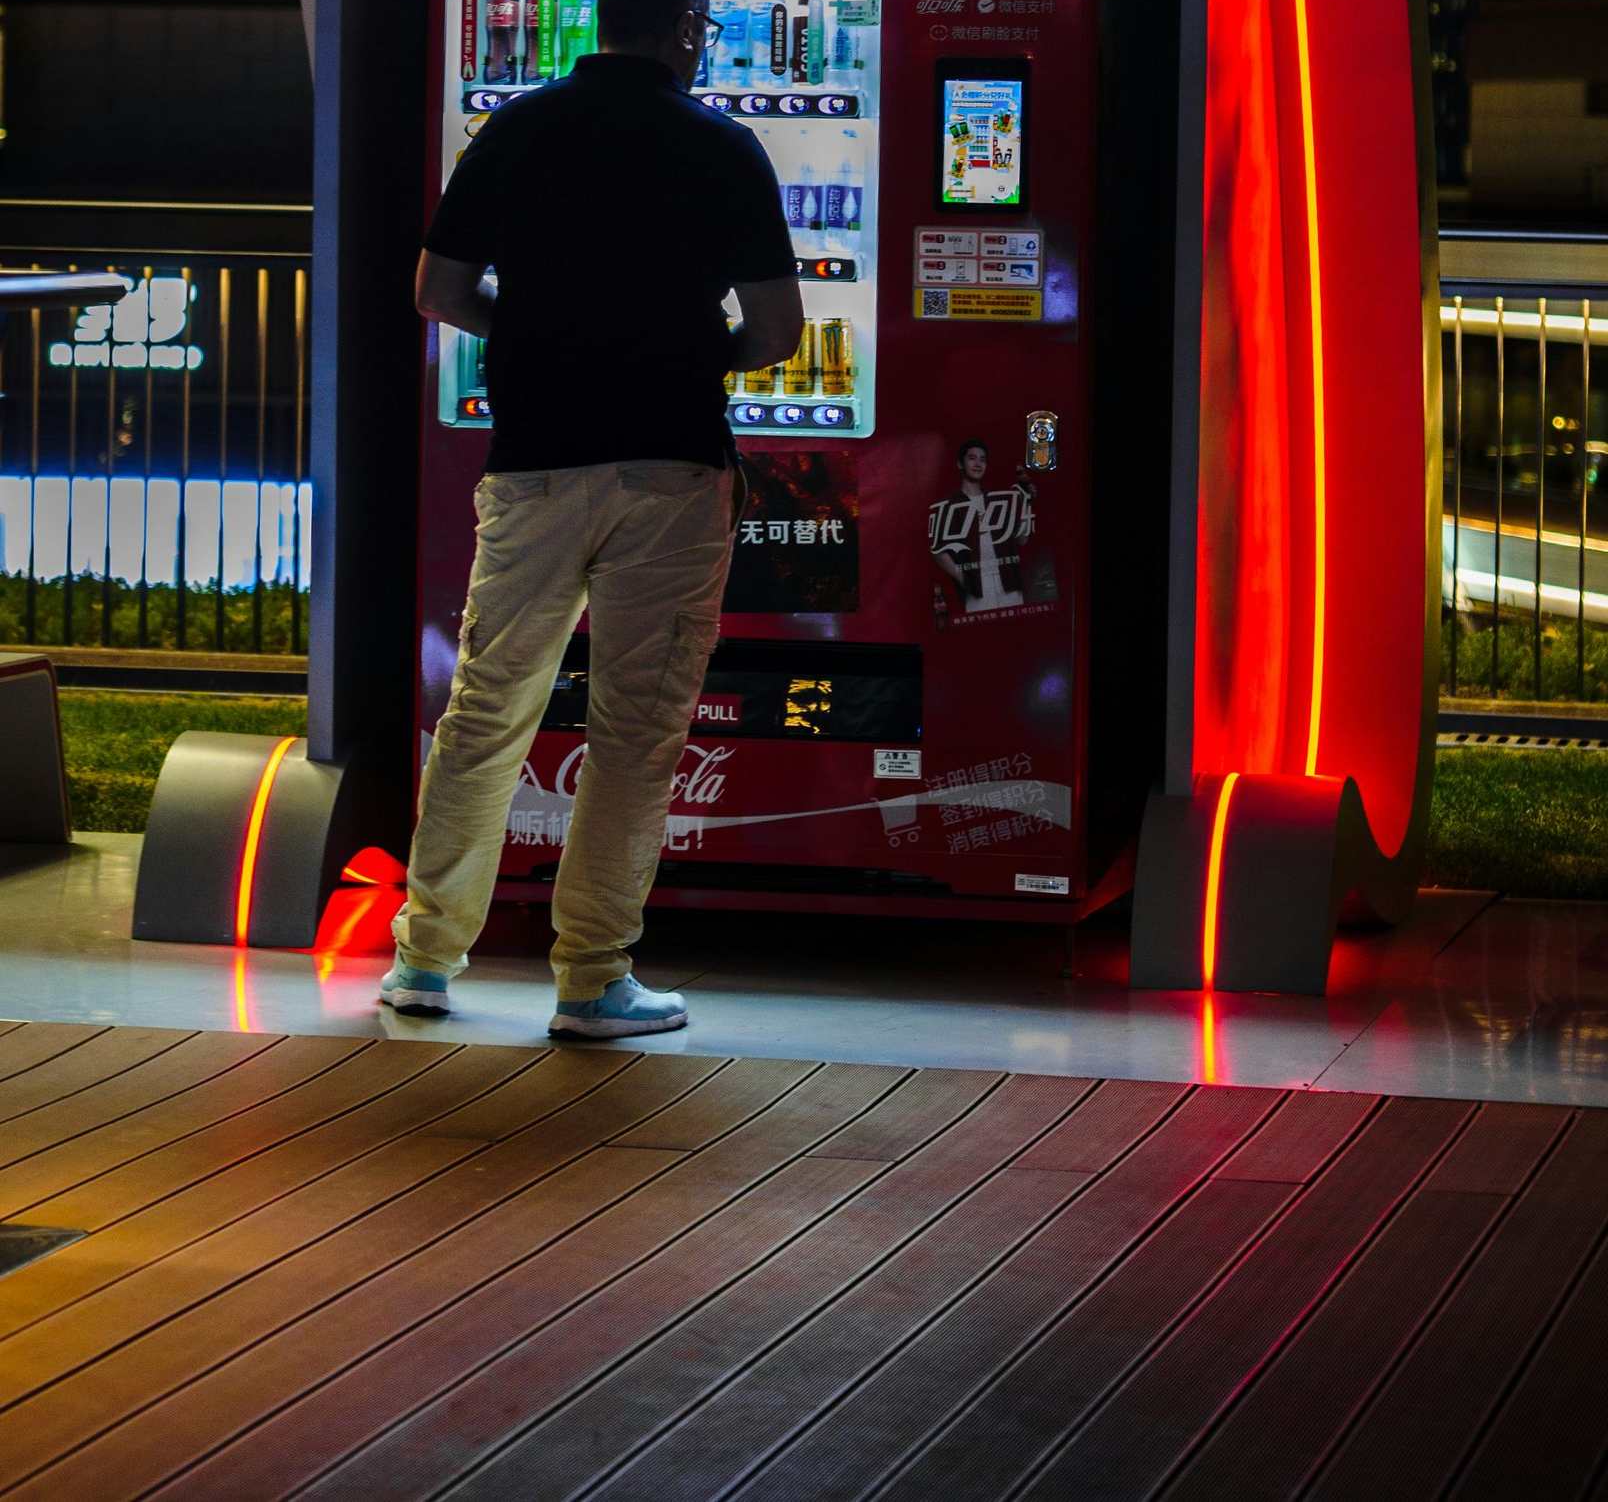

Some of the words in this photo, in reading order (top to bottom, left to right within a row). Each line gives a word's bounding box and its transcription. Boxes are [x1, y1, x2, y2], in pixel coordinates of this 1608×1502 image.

[998, 0, 1054, 14] 微信支付
[952, 26, 1040, 41] 微信刷脸支付
[740, 520, 845, 545] 无可替代
[698, 704, 738, 721] PULL
[924, 752, 1033, 797] 注册得积分
[939, 780, 1046, 826] 签到得积分
[946, 809, 1054, 855] 消费得积分
